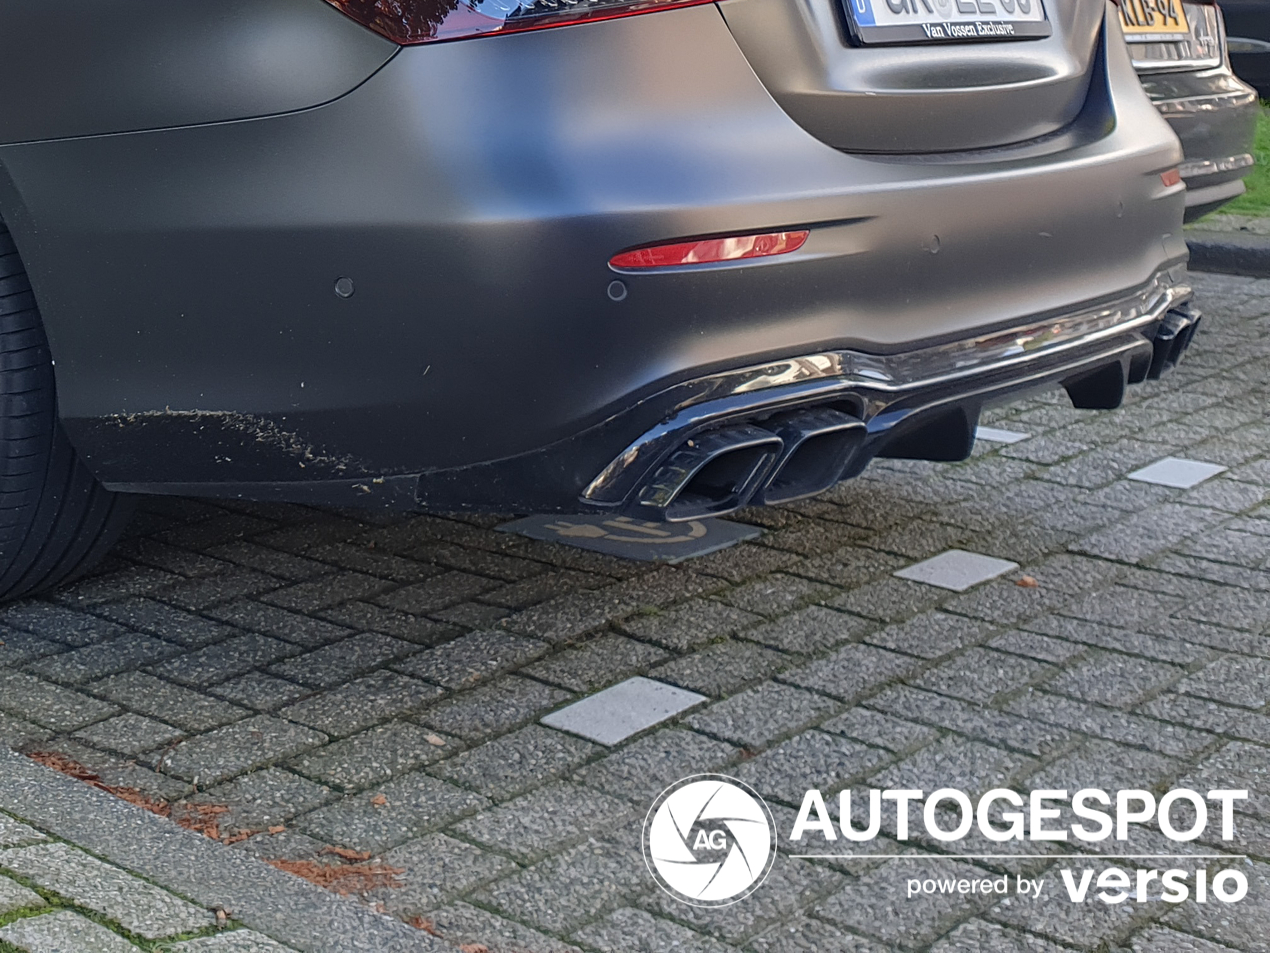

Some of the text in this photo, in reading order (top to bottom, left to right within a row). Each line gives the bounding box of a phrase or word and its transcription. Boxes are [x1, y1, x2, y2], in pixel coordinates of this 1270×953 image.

[922, 20, 1014, 38] Van Vossen Exclusive
